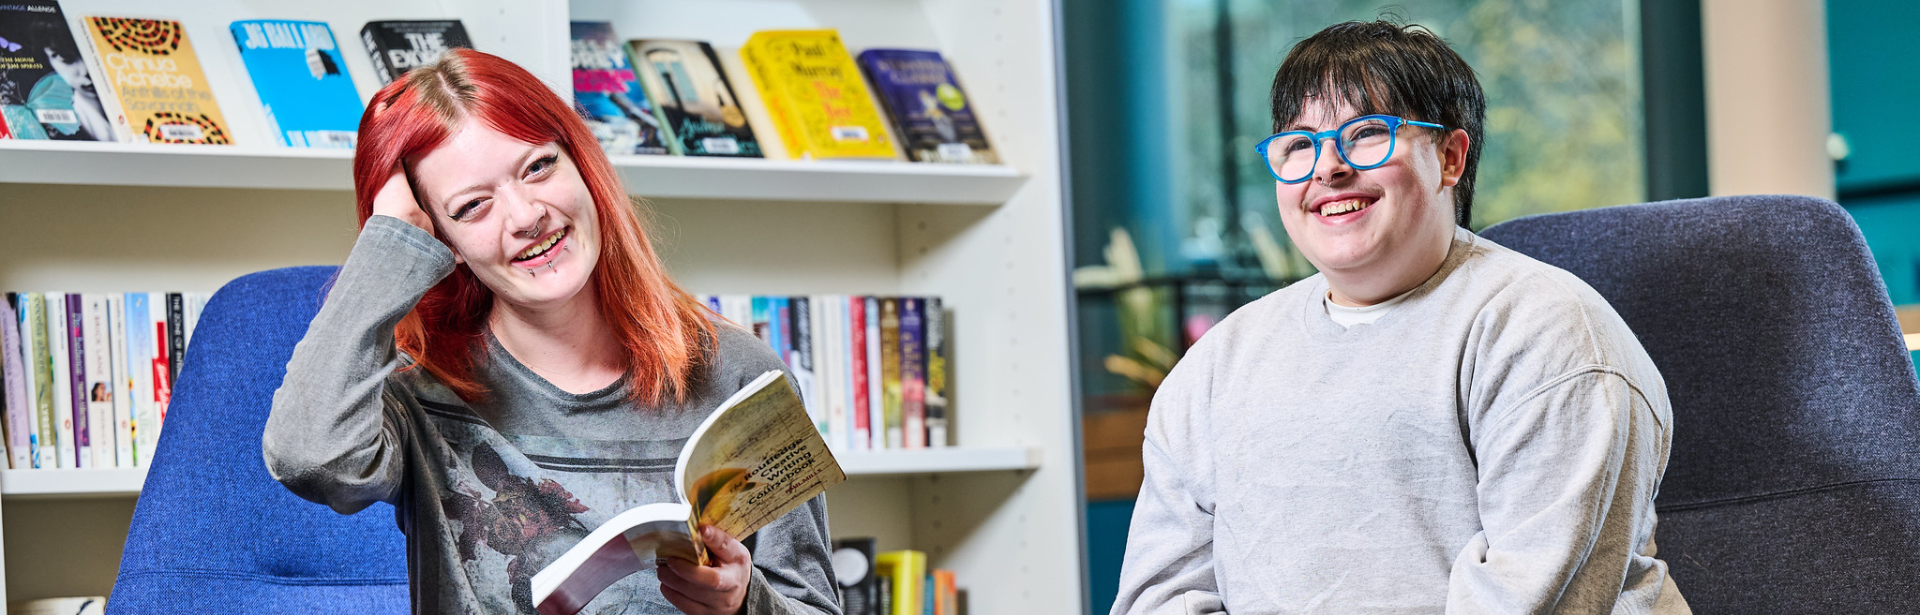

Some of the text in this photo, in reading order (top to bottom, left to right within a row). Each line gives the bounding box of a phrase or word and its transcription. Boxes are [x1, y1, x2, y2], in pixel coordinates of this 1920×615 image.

[28, 5, 57, 13] ALLENDE
[263, 22, 335, 50] BALLARD
[404, 32, 444, 51] THE
[788, 41, 825, 57] Paul
[106, 52, 177, 72] Chinua
[789, 61, 844, 81] Murray
[116, 68, 193, 89] Achebe
[122, 86, 211, 101] Anthills of the
[812, 81, 842, 100] The
[124, 98, 200, 113] Savannah
[822, 101, 853, 120] Bee
[173, 296, 181, 311] THE
[743, 438, 803, 481] Routledge
[760, 445, 807, 478] Creative
[767, 451, 812, 482] Writing
[748, 457, 816, 505] Coursebook
[785, 468, 823, 494] PAUL MILLS
